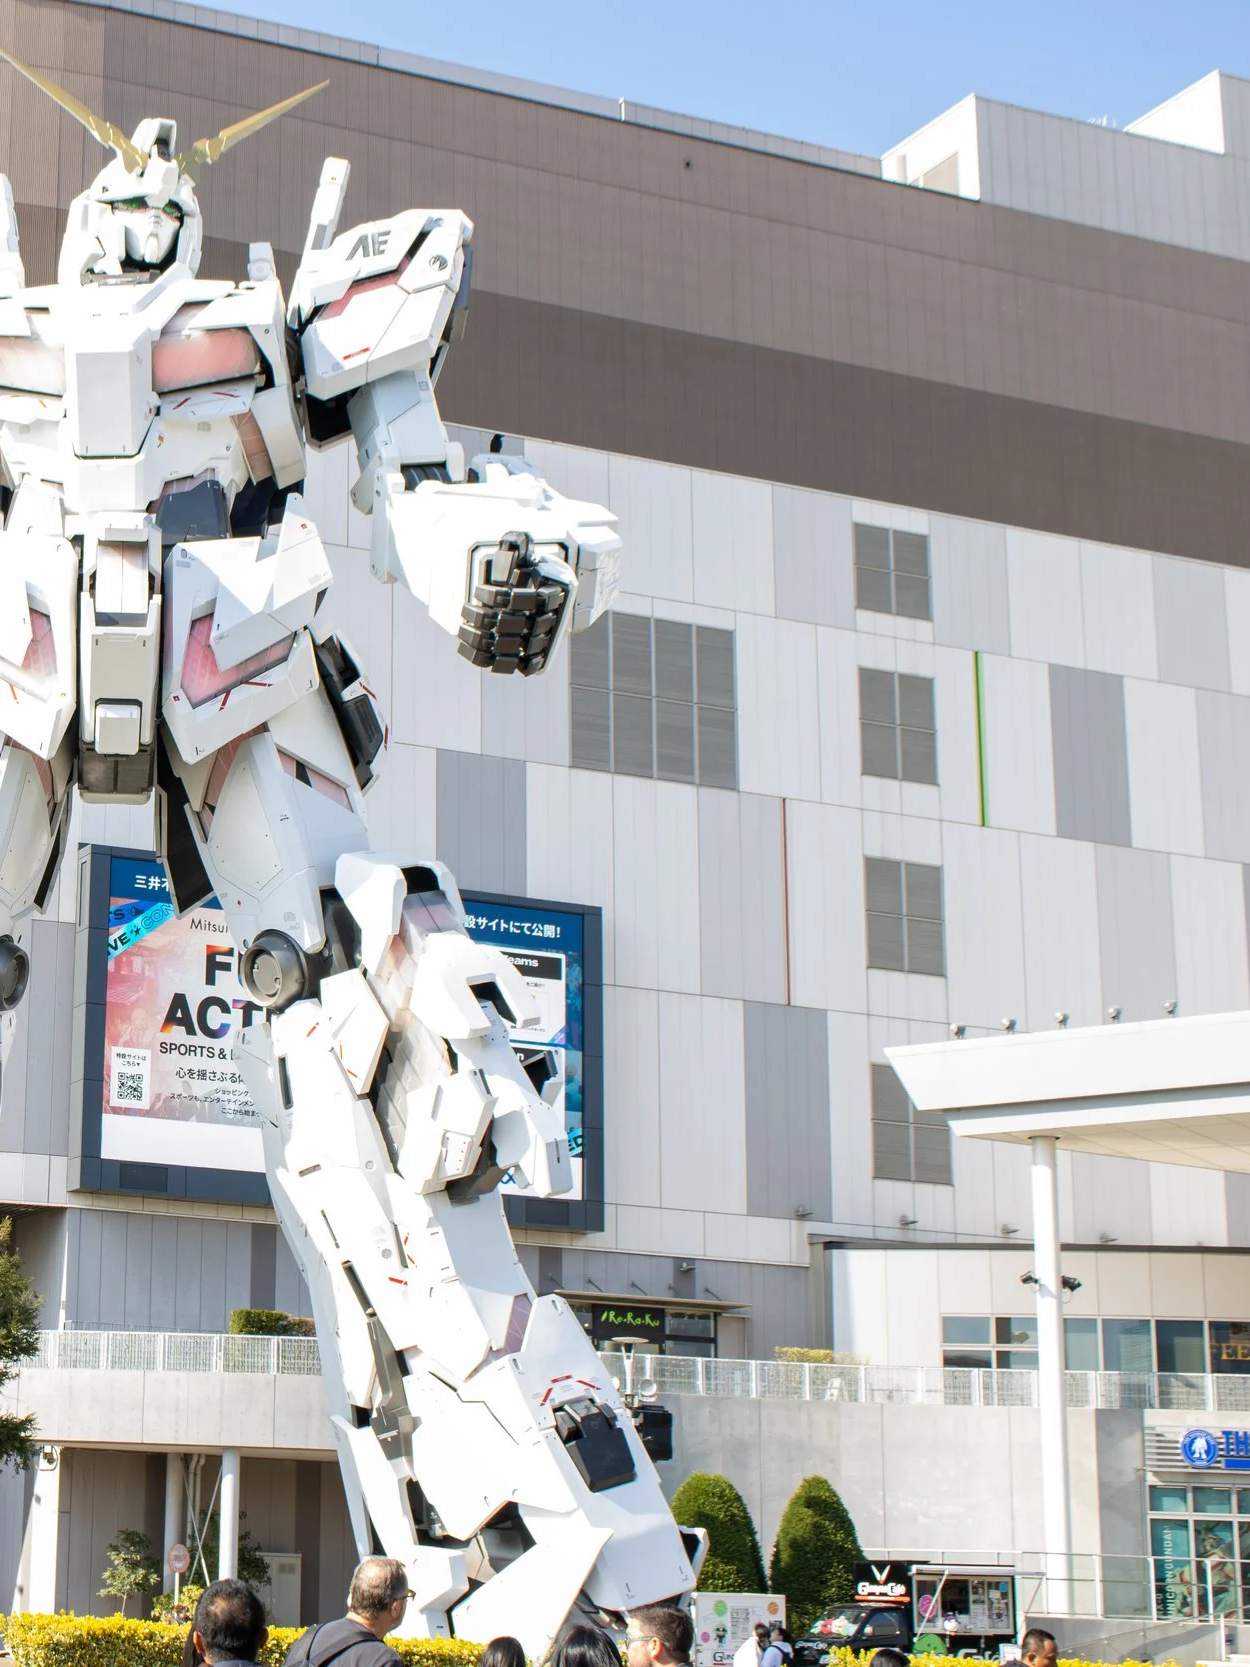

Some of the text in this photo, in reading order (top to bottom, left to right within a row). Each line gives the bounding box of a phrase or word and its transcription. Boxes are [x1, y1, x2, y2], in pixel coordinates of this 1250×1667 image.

[108, 931, 131, 956] VE
[204, 944, 244, 988] F
[506, 956, 539, 968] eams
[159, 1041, 216, 1060] SPORTS
[217, 1047, 228, 1061] &
